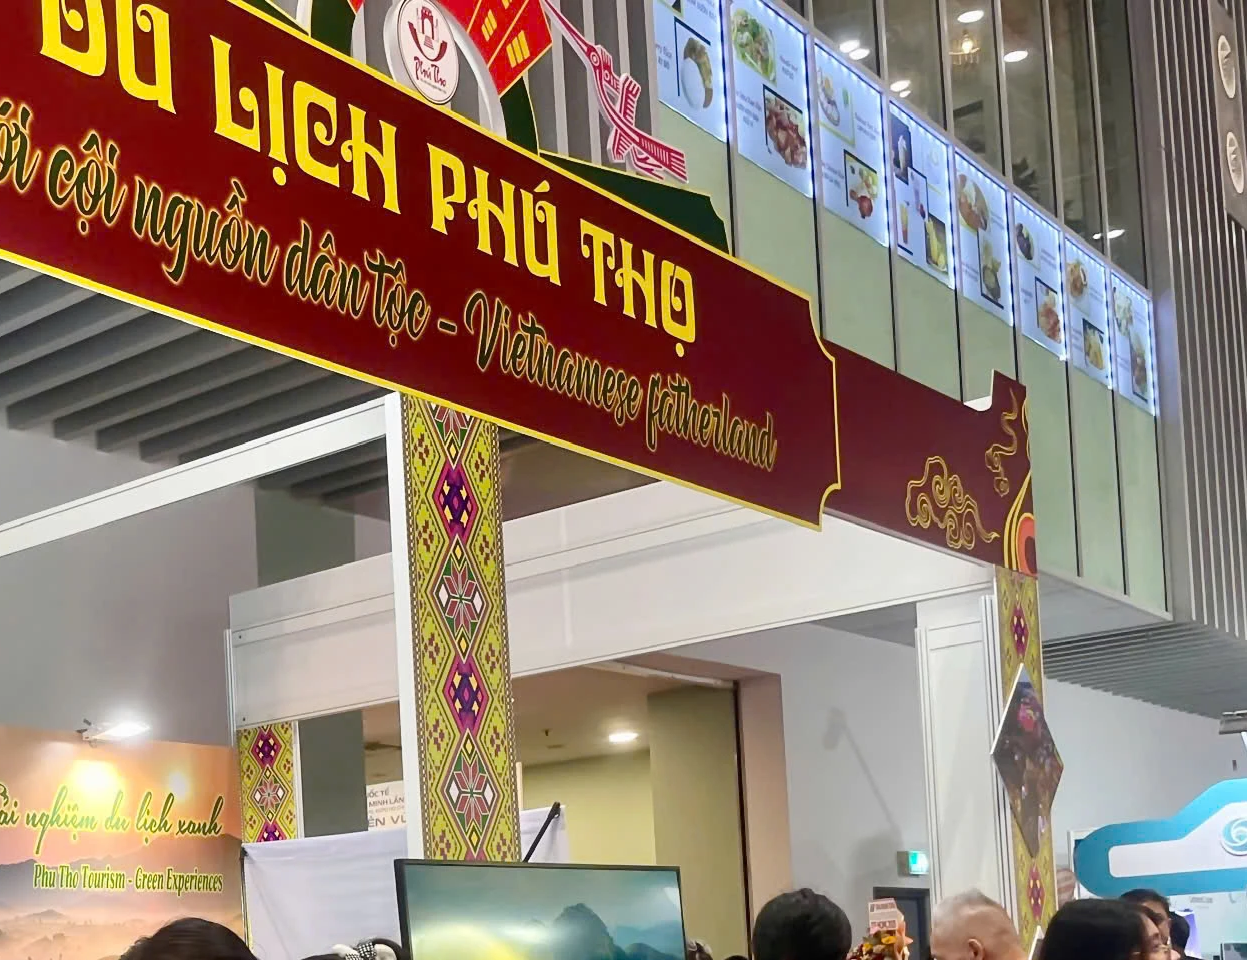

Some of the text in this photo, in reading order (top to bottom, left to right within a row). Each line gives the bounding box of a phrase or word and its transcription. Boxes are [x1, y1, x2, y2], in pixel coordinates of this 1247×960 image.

[40, 0, 696, 358] DU LỊCH PHÚ THỌ
[52, 138, 124, 232] cội
[135, 183, 276, 282] nguồn
[286, 222, 366, 316] dân
[366, 250, 430, 347] tộc
[438, 319, 457, 334] -
[465, 292, 642, 424] Vietnamese
[647, 374, 777, 470] fatherland
[26, 785, 97, 856] nghiệm
[104, 790, 129, 831] du
[136, 791, 174, 845] lịch
[176, 795, 224, 836] xanh
[34, 864, 56, 888] Phu
[59, 864, 80, 889] Tho
[82, 864, 125, 890] Tourism
[135, 867, 164, 891] Green
[165, 867, 223, 896] Experiences
